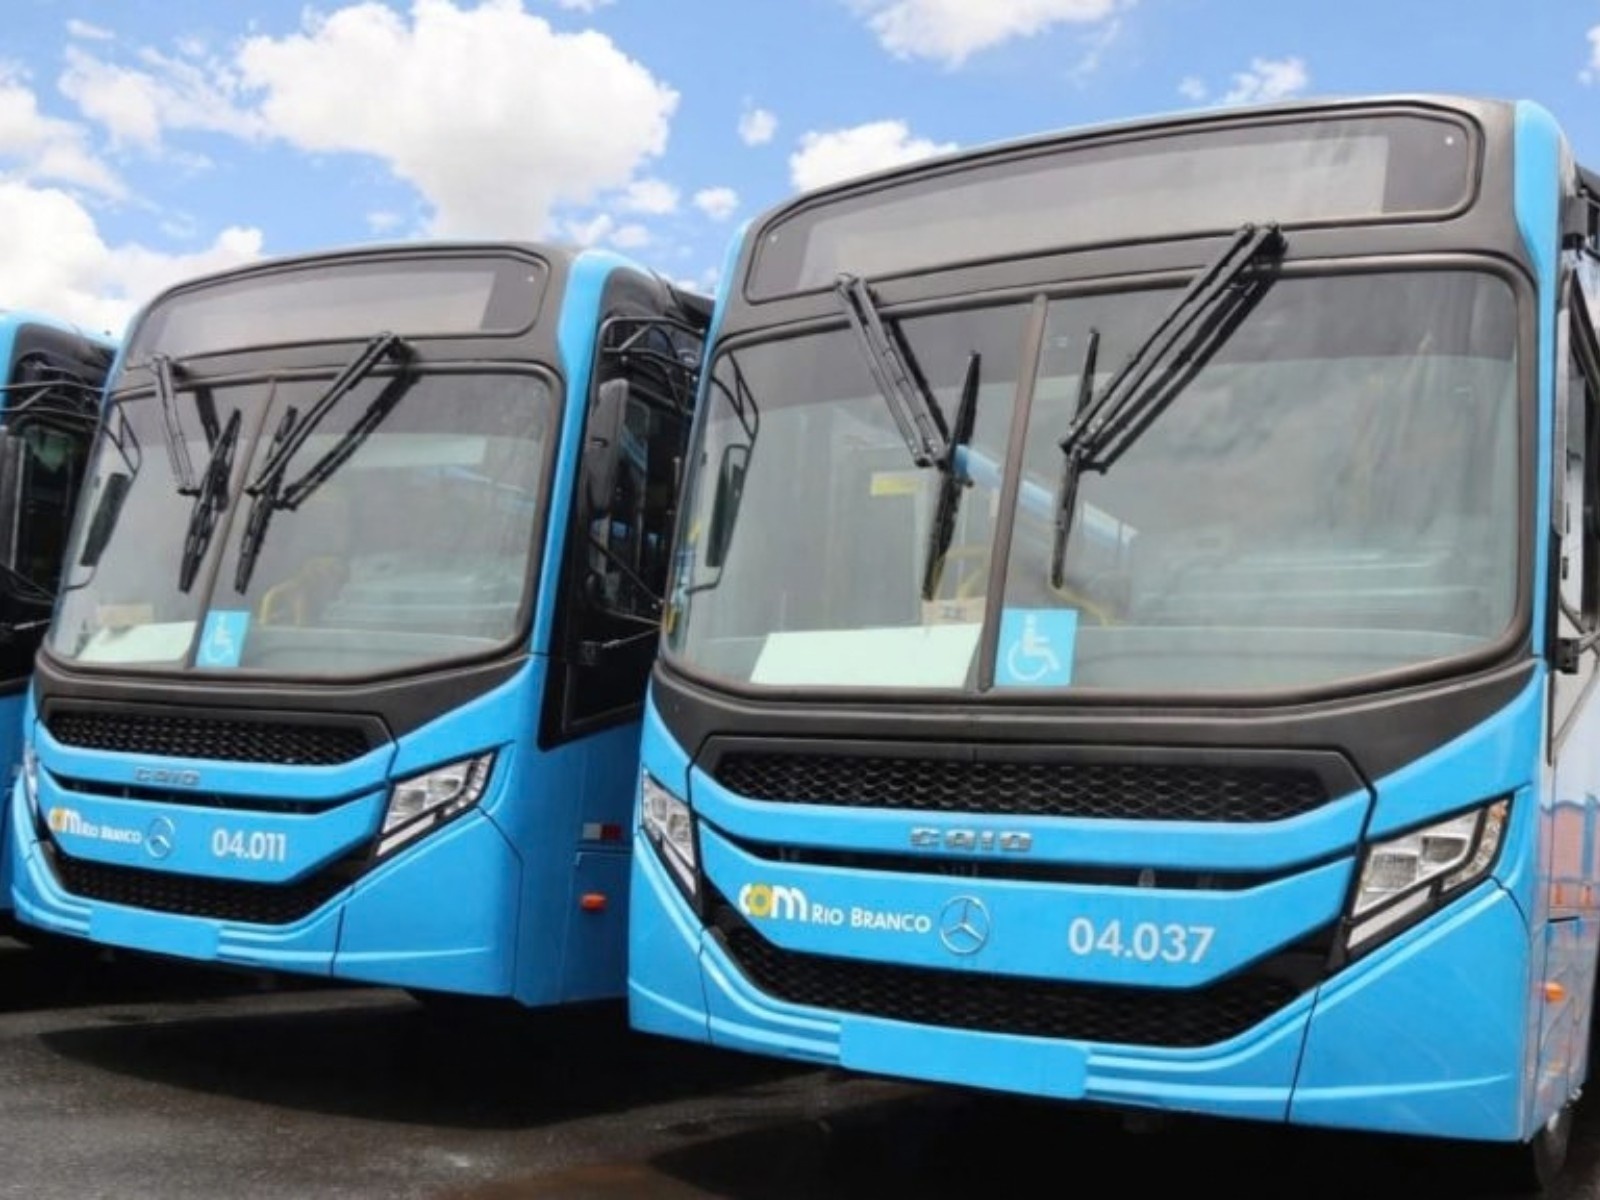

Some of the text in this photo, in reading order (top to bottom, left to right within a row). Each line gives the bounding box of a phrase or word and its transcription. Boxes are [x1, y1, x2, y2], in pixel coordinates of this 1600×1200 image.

[211, 827, 286, 862] 04.011
[811, 903, 845, 926] RIO
[850, 906, 932, 934] BRANCO
[1067, 916, 1216, 964] 04.037
